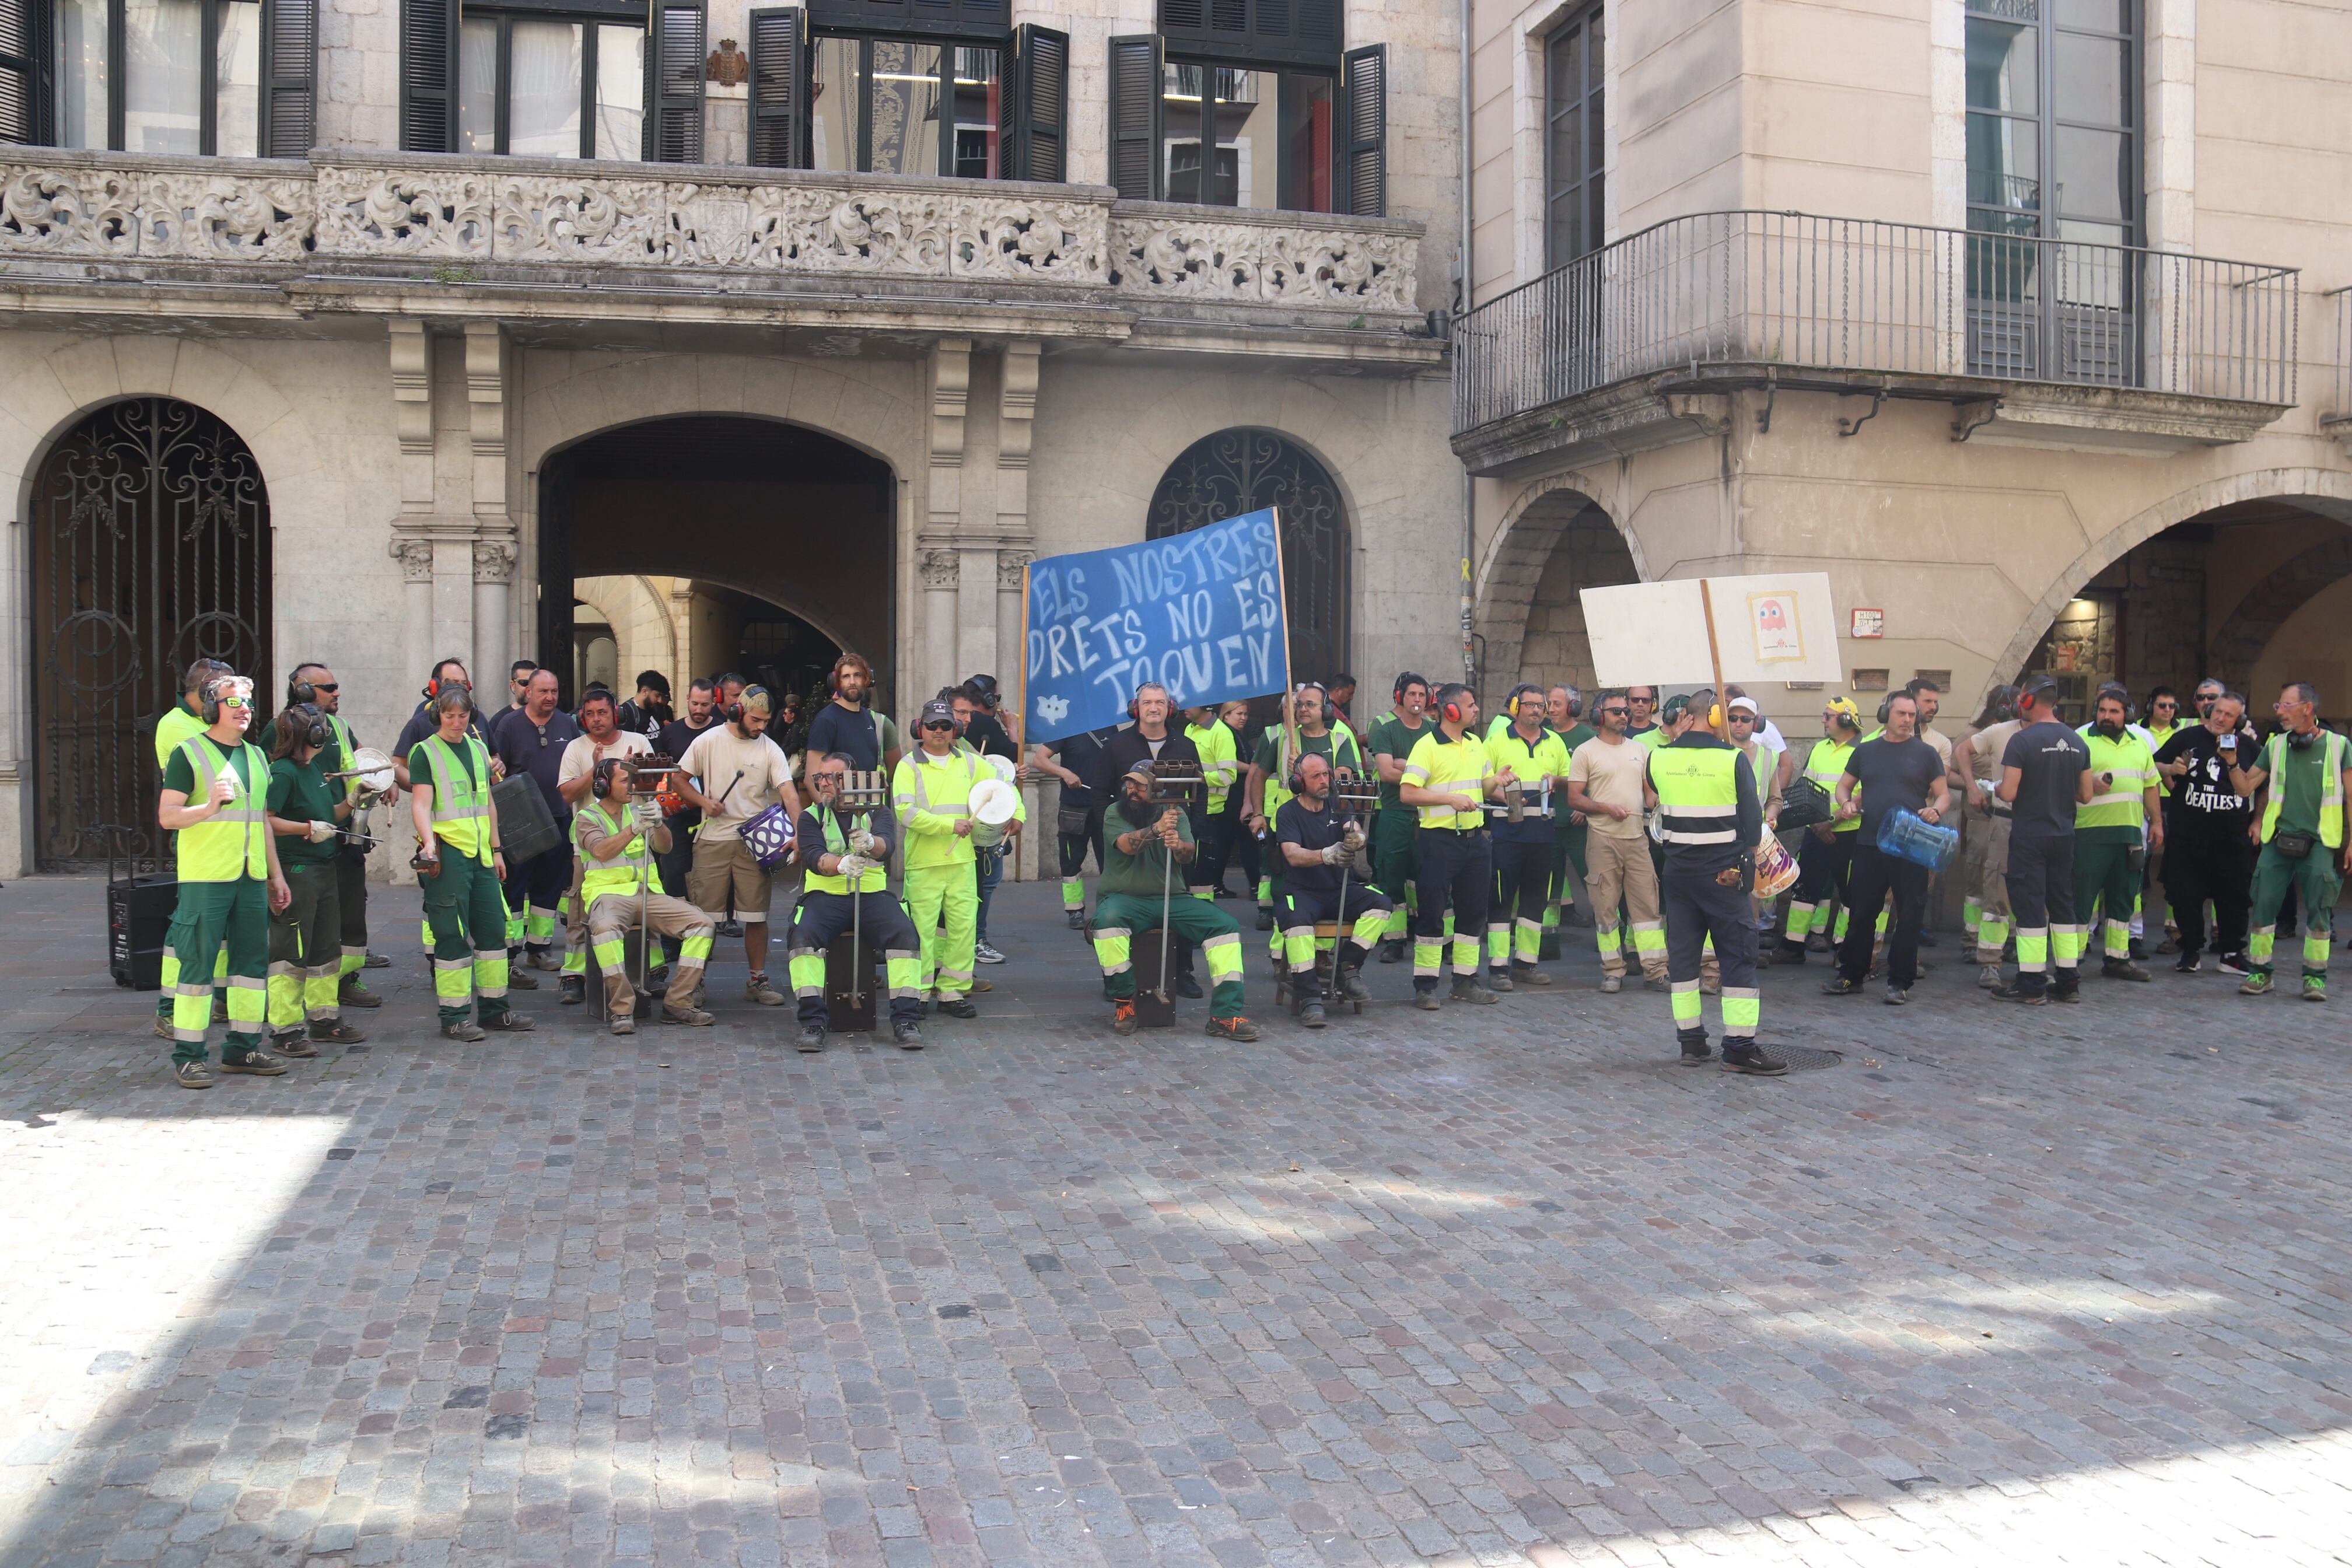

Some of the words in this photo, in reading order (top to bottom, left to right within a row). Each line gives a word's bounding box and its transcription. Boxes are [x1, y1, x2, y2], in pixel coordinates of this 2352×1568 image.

[1032, 567, 1089, 626] ELS
[1111, 518, 1276, 607] NOSTRES
[1029, 609, 1147, 681] DRETS
[1167, 589, 1213, 642] NO
[1233, 570, 1277, 631] ES
[1093, 631, 1272, 715] TOQUEN
[2185, 782, 2234, 813] BEATLES
[2203, 784, 2215, 792] THE
